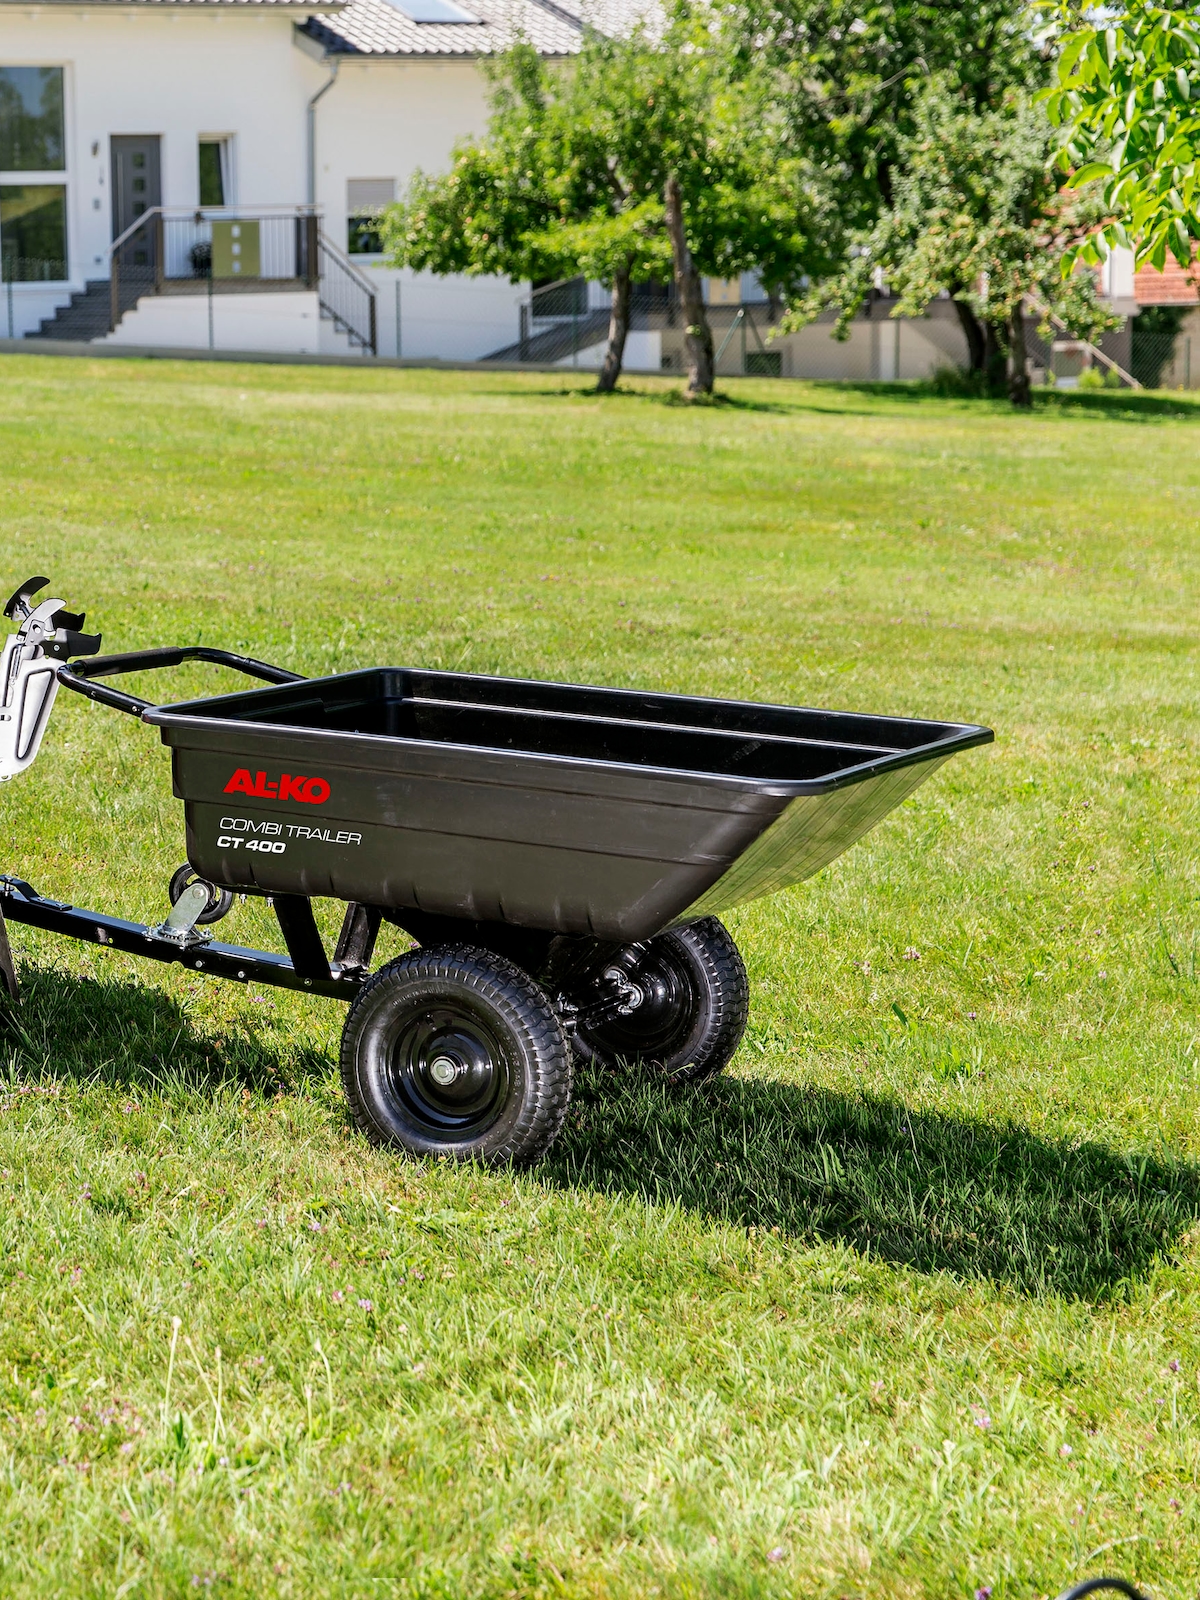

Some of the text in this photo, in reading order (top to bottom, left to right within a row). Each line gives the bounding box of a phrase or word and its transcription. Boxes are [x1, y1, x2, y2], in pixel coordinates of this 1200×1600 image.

[222, 768, 331, 805] AL-KO
[217, 836, 287, 854] CT 400
[220, 817, 362, 845] COMBI TRAILER
